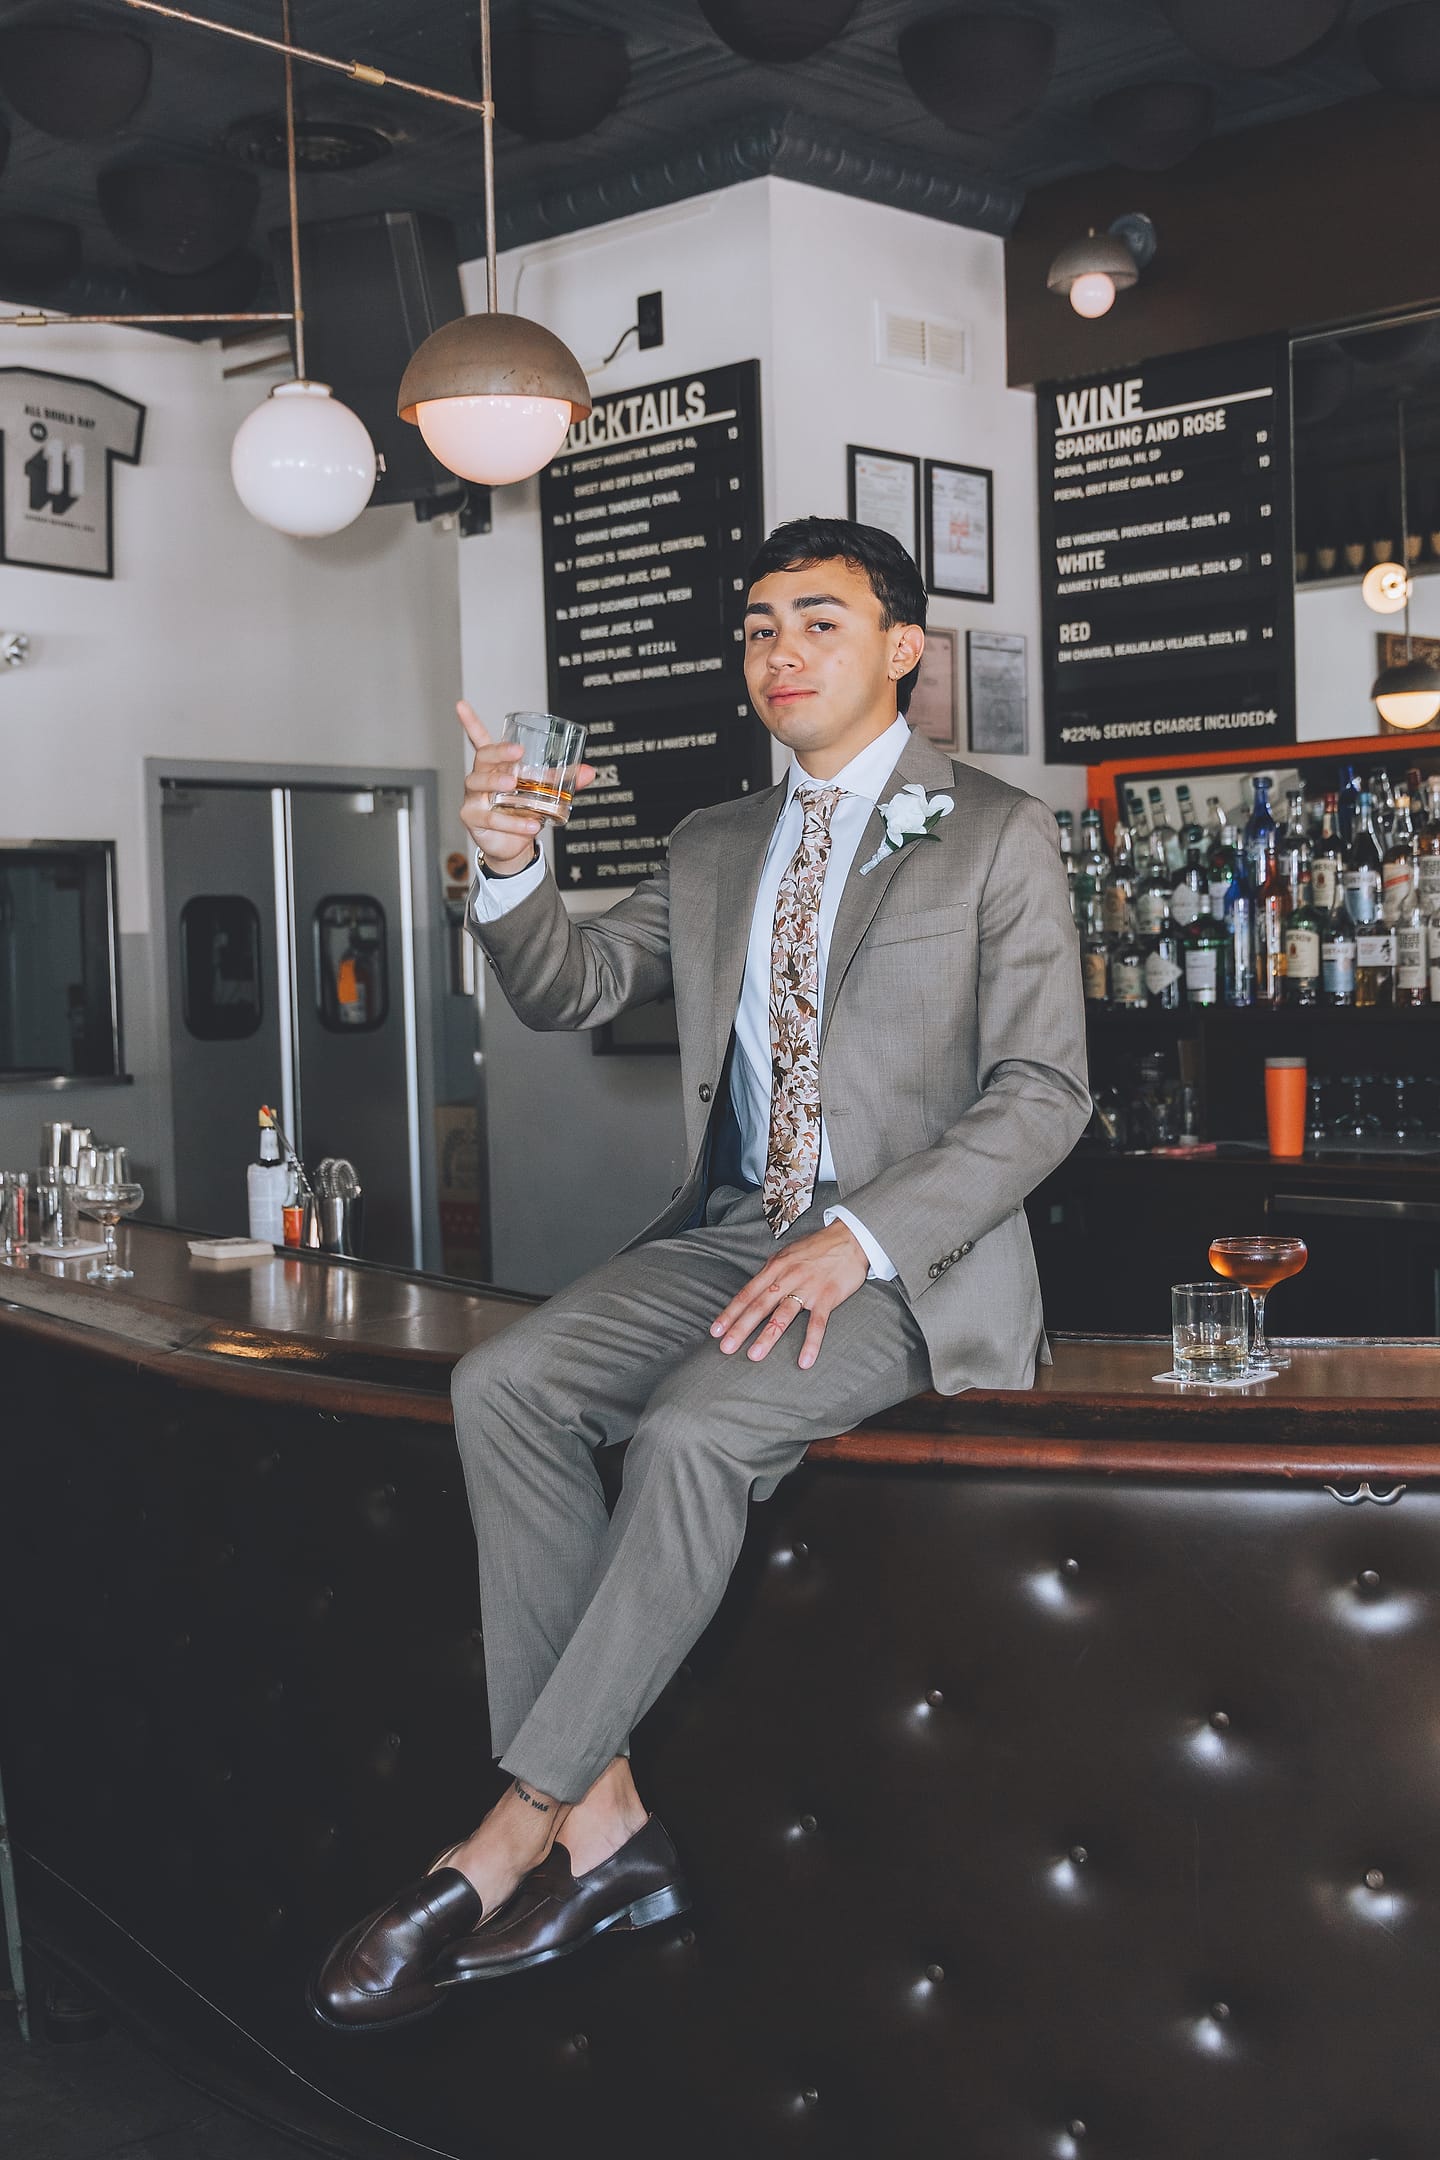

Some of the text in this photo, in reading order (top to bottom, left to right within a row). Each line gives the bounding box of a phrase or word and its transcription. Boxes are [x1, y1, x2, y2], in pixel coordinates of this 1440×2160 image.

[564, 379, 706, 448] OCKTAILS
[1055, 377, 1143, 429] WINE
[1055, 408, 1225, 460] SPARKLING AND ROSÉ
[1056, 549, 1105, 575] WHITE
[1059, 621, 1090, 643] RED
[1103, 720, 1152, 739] SERVICE
[1153, 716, 1201, 735] CHARGE
[1204, 709, 1264, 730] INCLUDED
